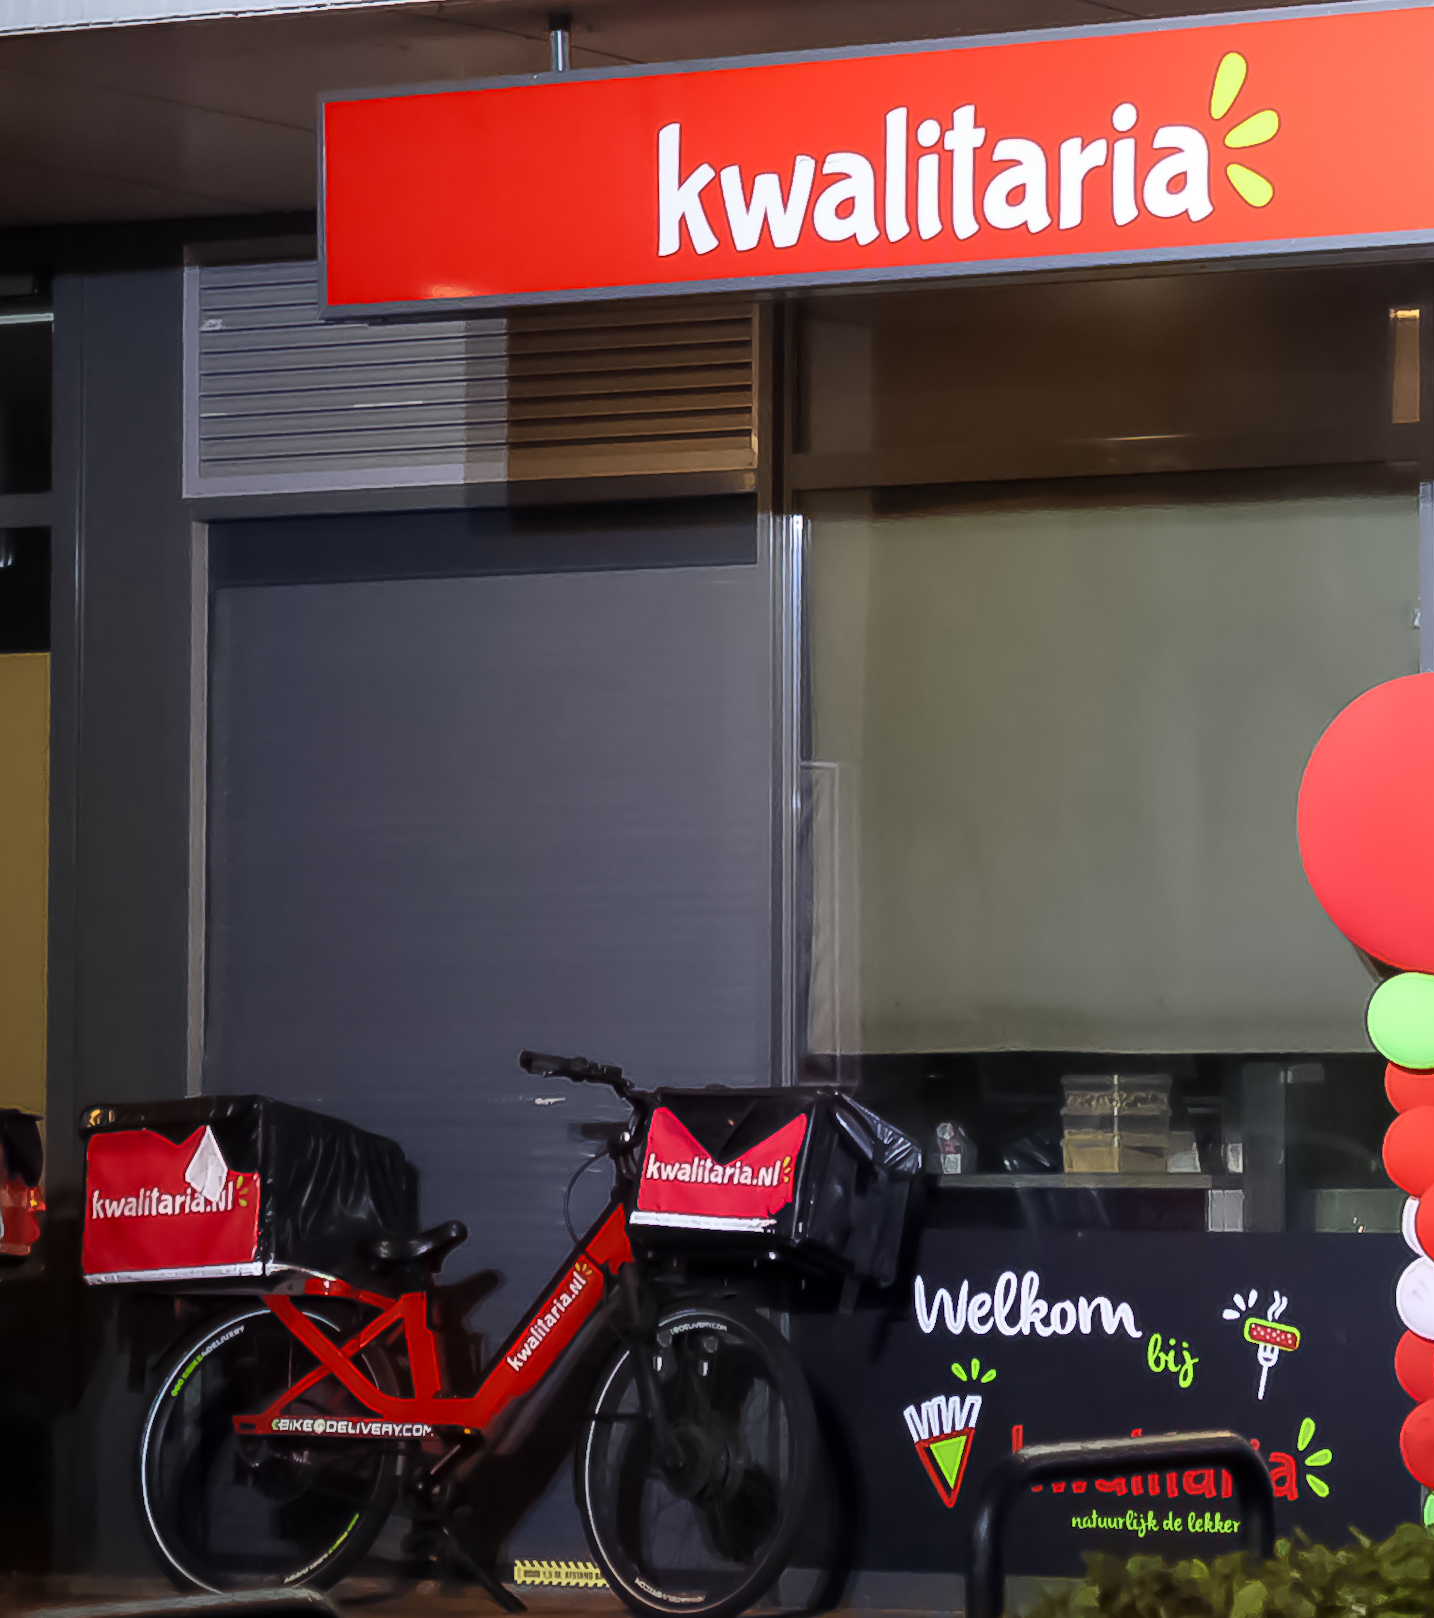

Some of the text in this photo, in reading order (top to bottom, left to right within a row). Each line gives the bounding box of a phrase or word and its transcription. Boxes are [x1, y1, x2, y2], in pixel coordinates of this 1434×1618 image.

[657, 102, 1214, 257] kwalitaria
[914, 1270, 1143, 1339] Welkom
[1147, 1332, 1199, 1388] bij
[1071, 1509, 1241, 1538] natuurlijk de lekker
